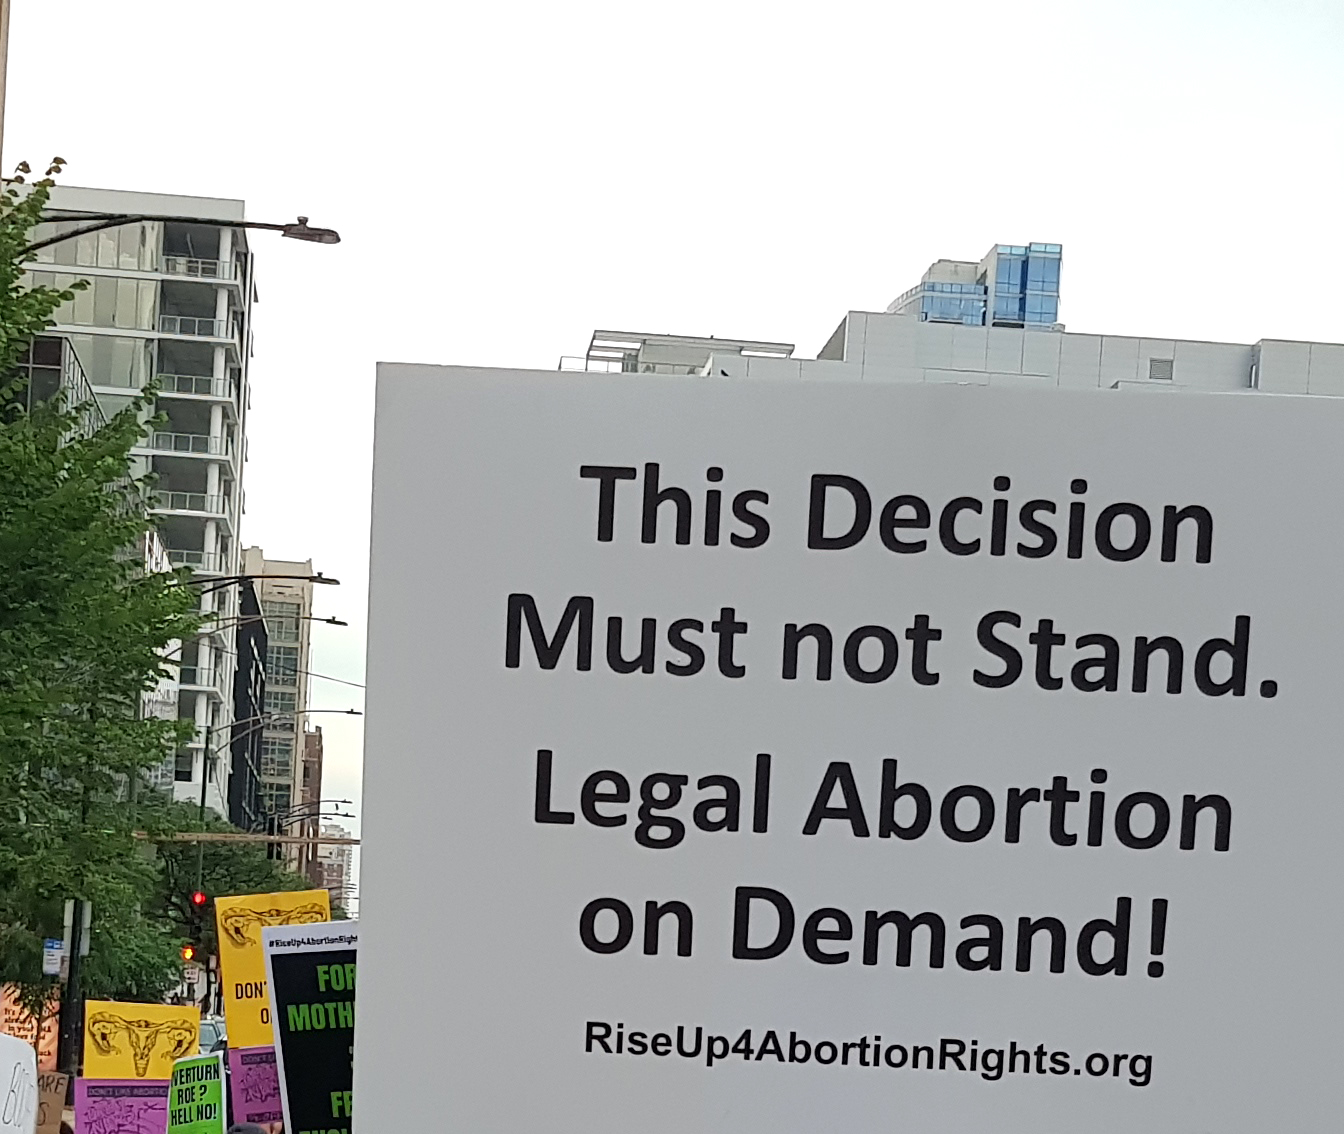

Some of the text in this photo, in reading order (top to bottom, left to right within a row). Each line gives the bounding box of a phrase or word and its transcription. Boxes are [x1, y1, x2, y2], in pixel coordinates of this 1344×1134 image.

[580, 463, 1213, 563] This Decision
[506, 593, 1277, 698] Must not Stand.
[535, 750, 1231, 851] Legal Abortion
[580, 886, 1168, 978] on Demand!
[235, 981, 267, 1000] DON'
[317, 963, 355, 992] FOR
[287, 1001, 355, 1031] MOTH
[586, 1022, 1152, 1086] RiseUp4AbortionRights.org
[171, 1063, 220, 1088] VERTURN
[133, 1088, 168, 1096] ABORTIO
[177, 1087, 196, 1105] ROE
[171, 1102, 217, 1126] HELL NO!
